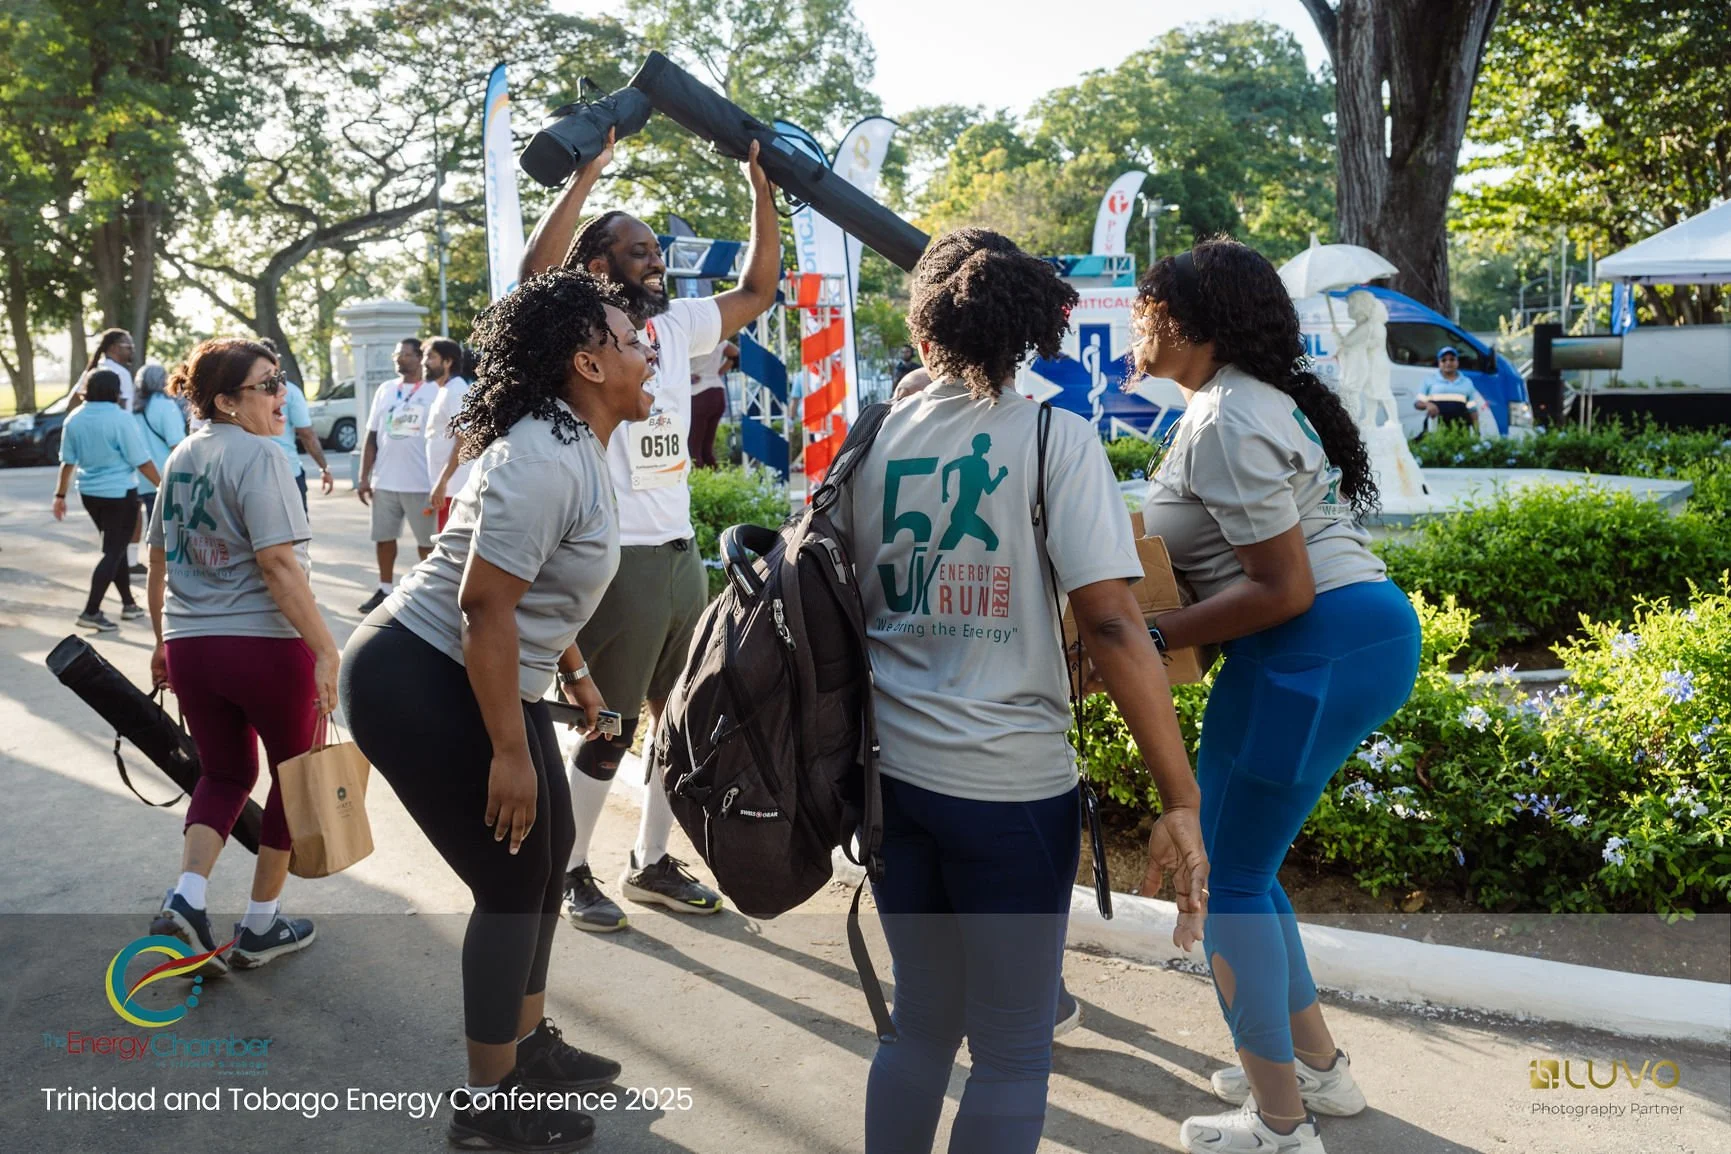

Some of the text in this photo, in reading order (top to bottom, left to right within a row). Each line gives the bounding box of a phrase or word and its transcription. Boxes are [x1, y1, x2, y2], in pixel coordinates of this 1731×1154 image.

[640, 433, 680, 458] 0518
[939, 563, 991, 581] ENERGY
[939, 584, 989, 617] RUN
[993, 566, 1010, 617] 2025
[932, 622, 957, 636] the
